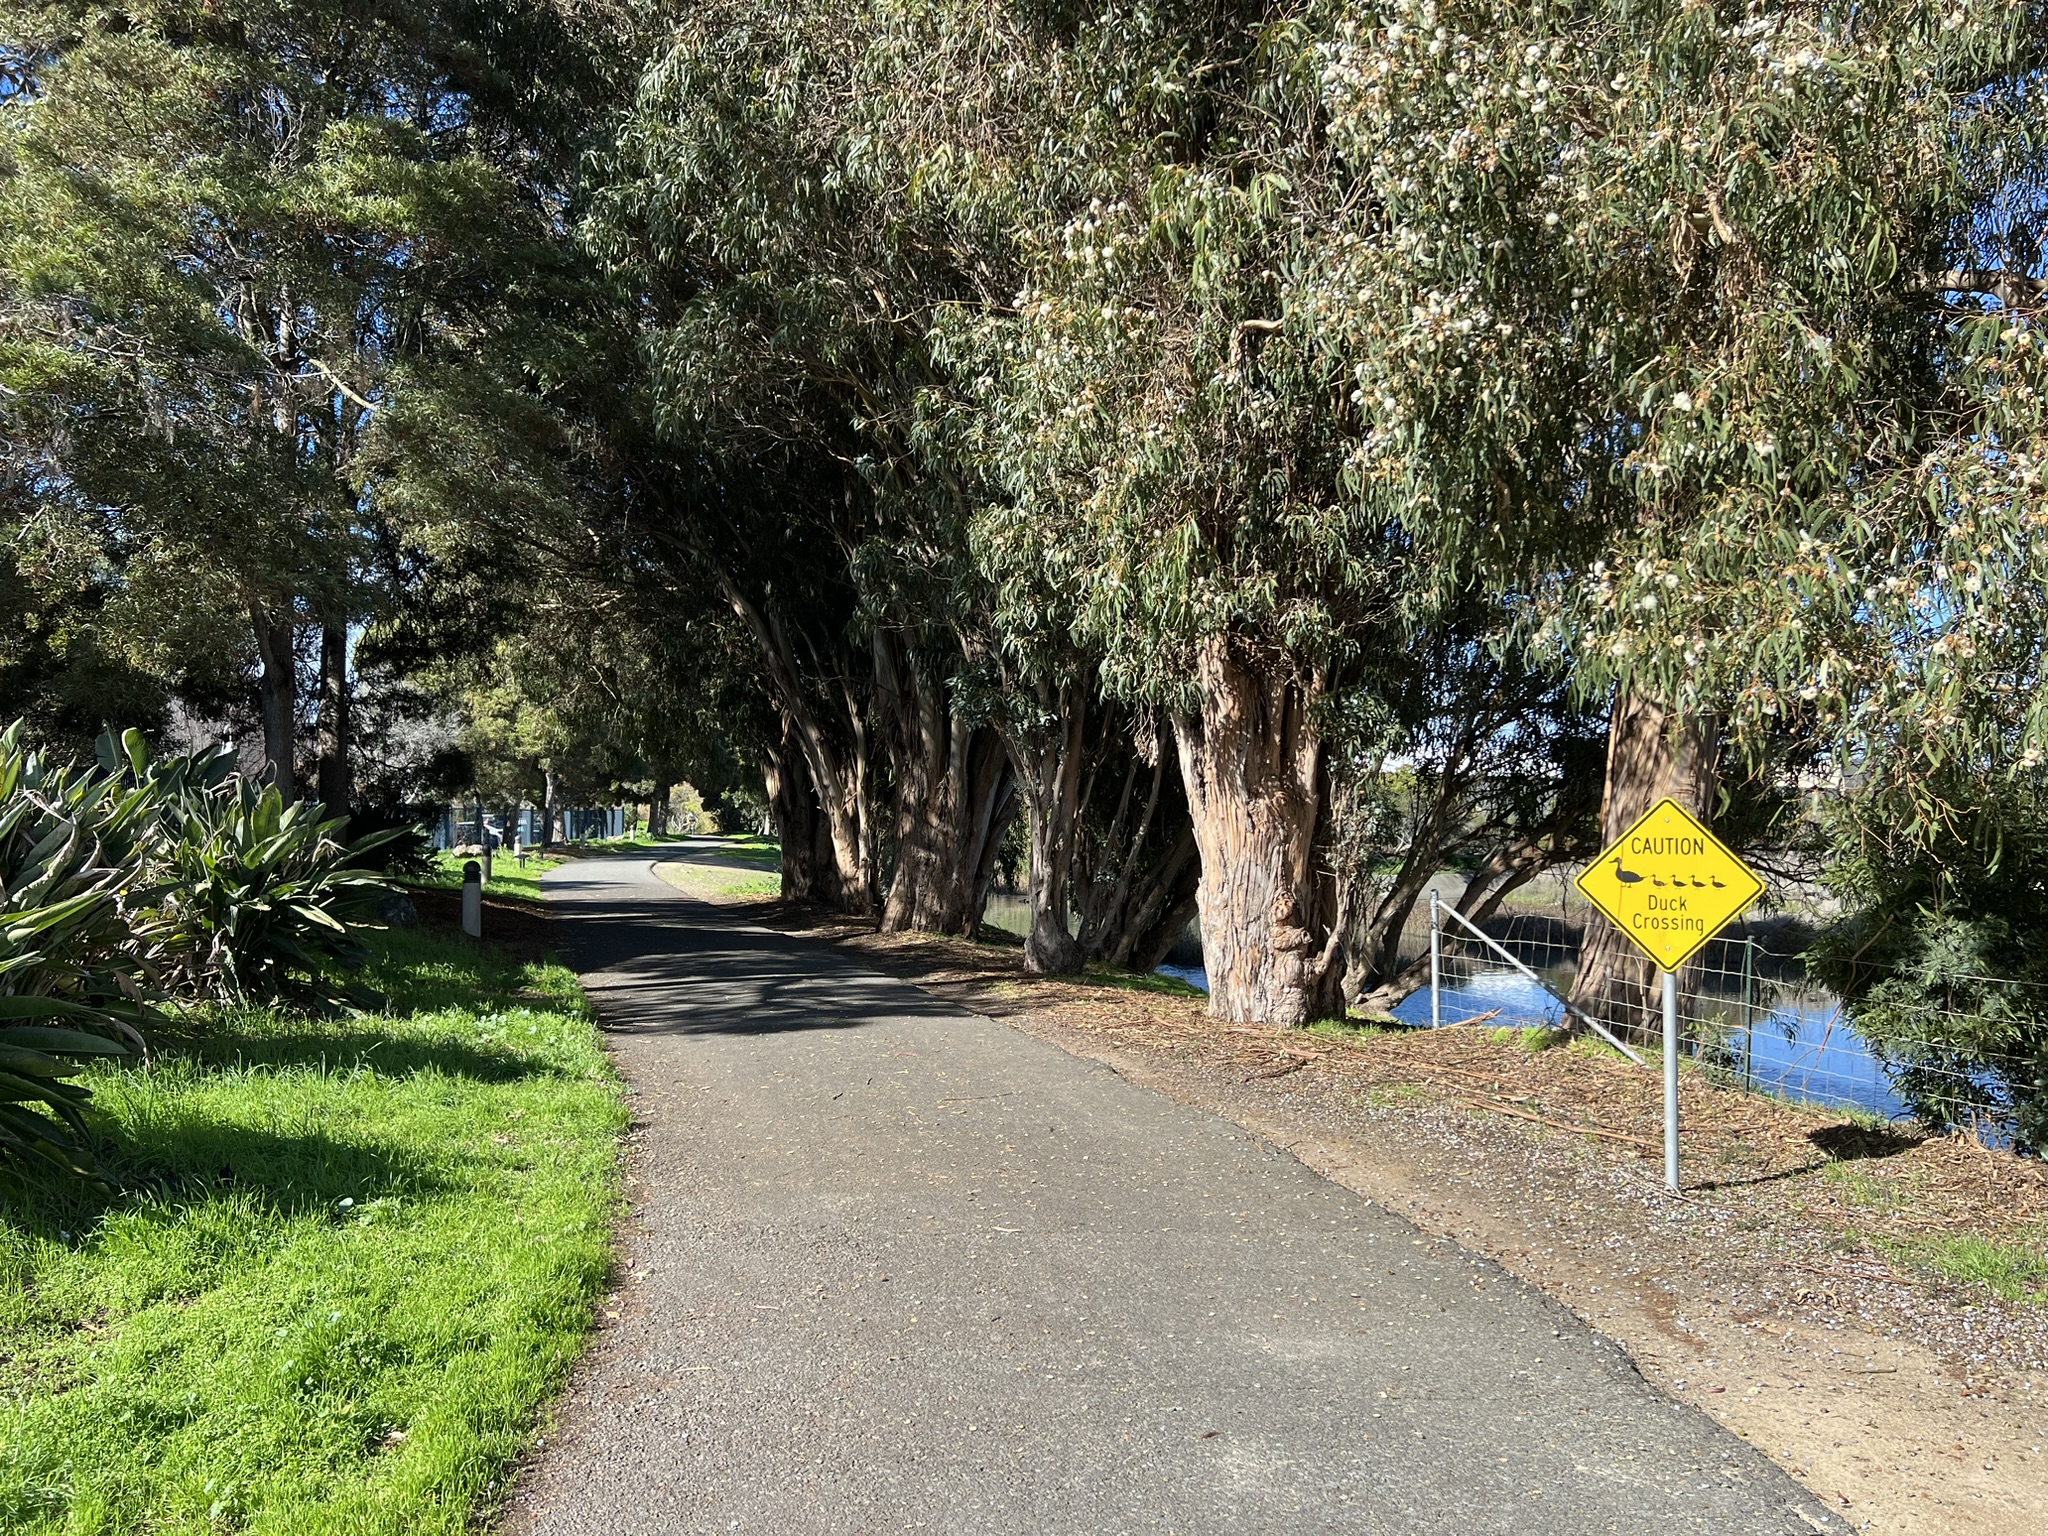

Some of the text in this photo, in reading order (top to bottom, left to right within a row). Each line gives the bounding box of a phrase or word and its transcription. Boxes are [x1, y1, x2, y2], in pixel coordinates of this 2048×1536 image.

[1631, 837, 1704, 855] CAUTION
[1648, 894, 1688, 911] Duck
[1633, 913, 1704, 936] Crossing
